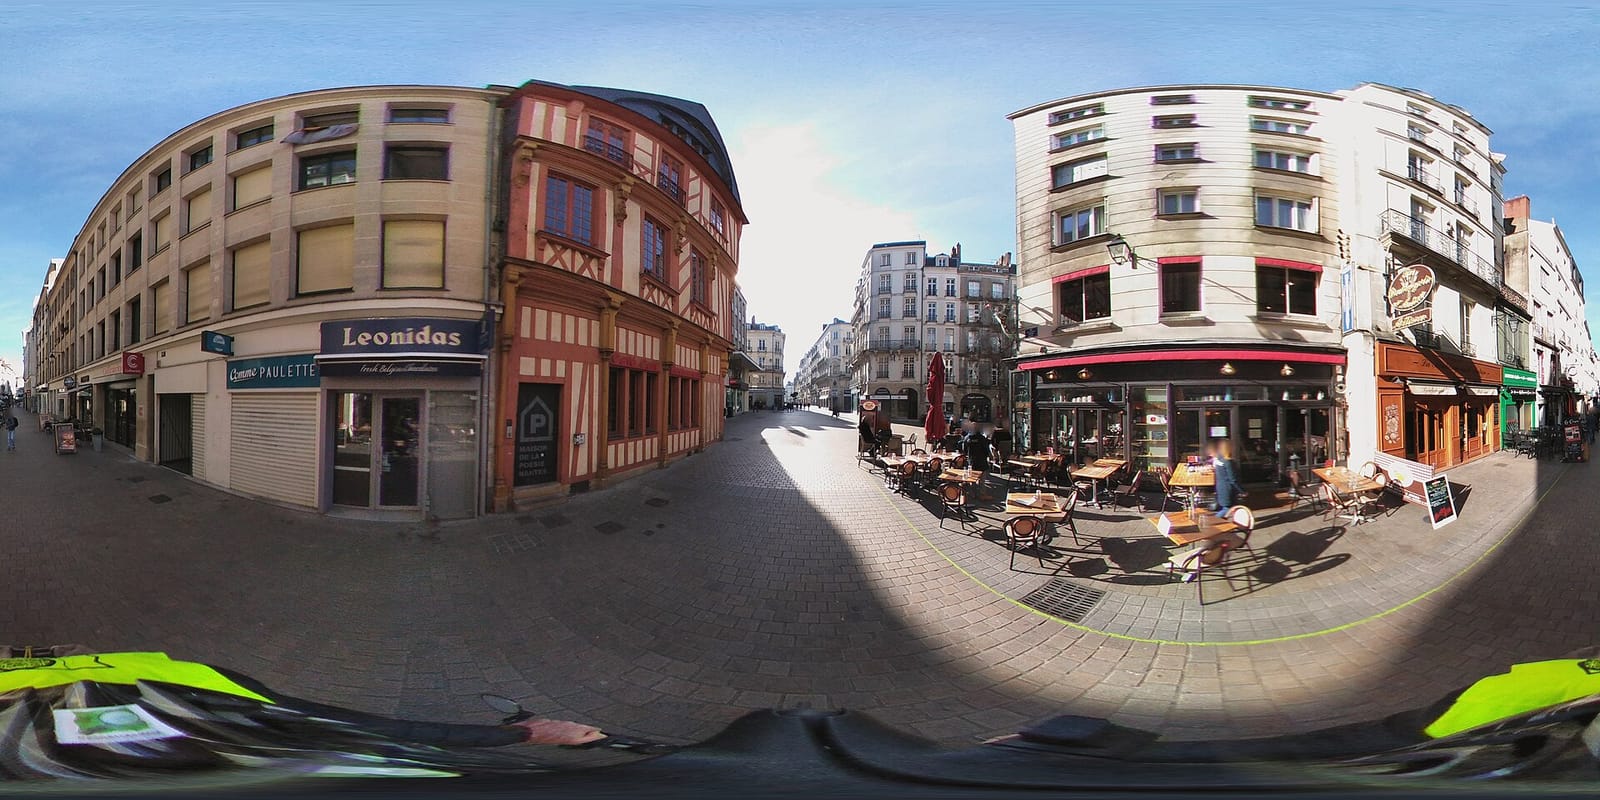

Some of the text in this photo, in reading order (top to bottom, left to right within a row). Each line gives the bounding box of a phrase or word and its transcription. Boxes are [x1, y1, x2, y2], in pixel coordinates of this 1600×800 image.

[342, 325, 462, 347] Leonidas
[229, 364, 316, 383] Comme PAULETTE
[529, 413, 547, 434] P
